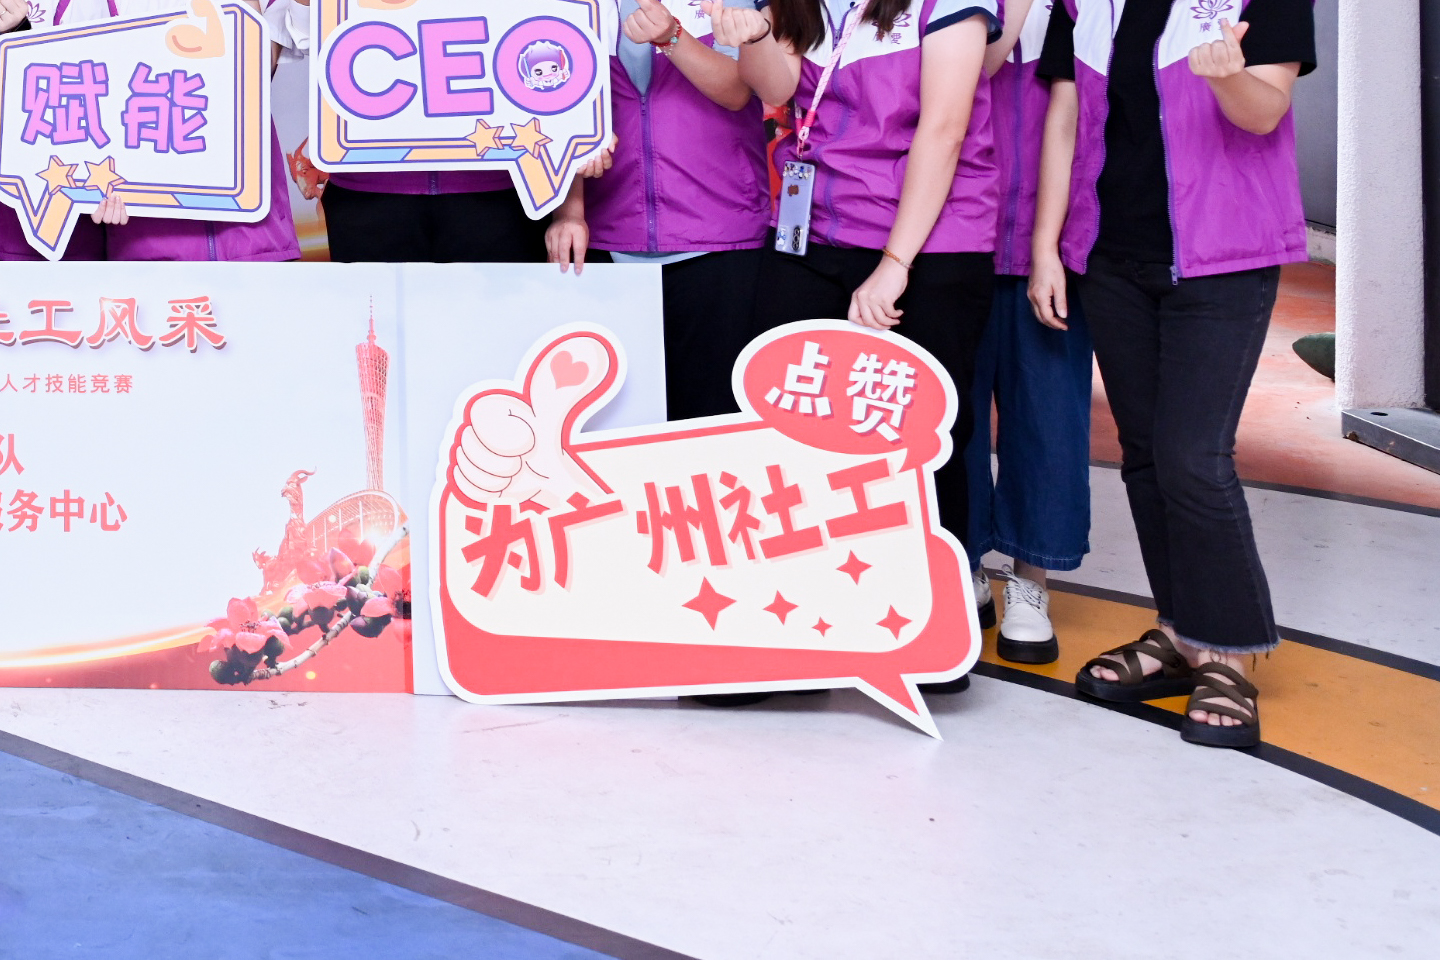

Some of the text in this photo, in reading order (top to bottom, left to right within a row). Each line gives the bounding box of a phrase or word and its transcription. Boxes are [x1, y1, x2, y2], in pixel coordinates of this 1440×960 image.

[20, 60, 209, 155] 赋能
[325, 14, 598, 121] CEO
[764, 341, 917, 442] 点赞
[461, 458, 909, 598] 为广州社工
